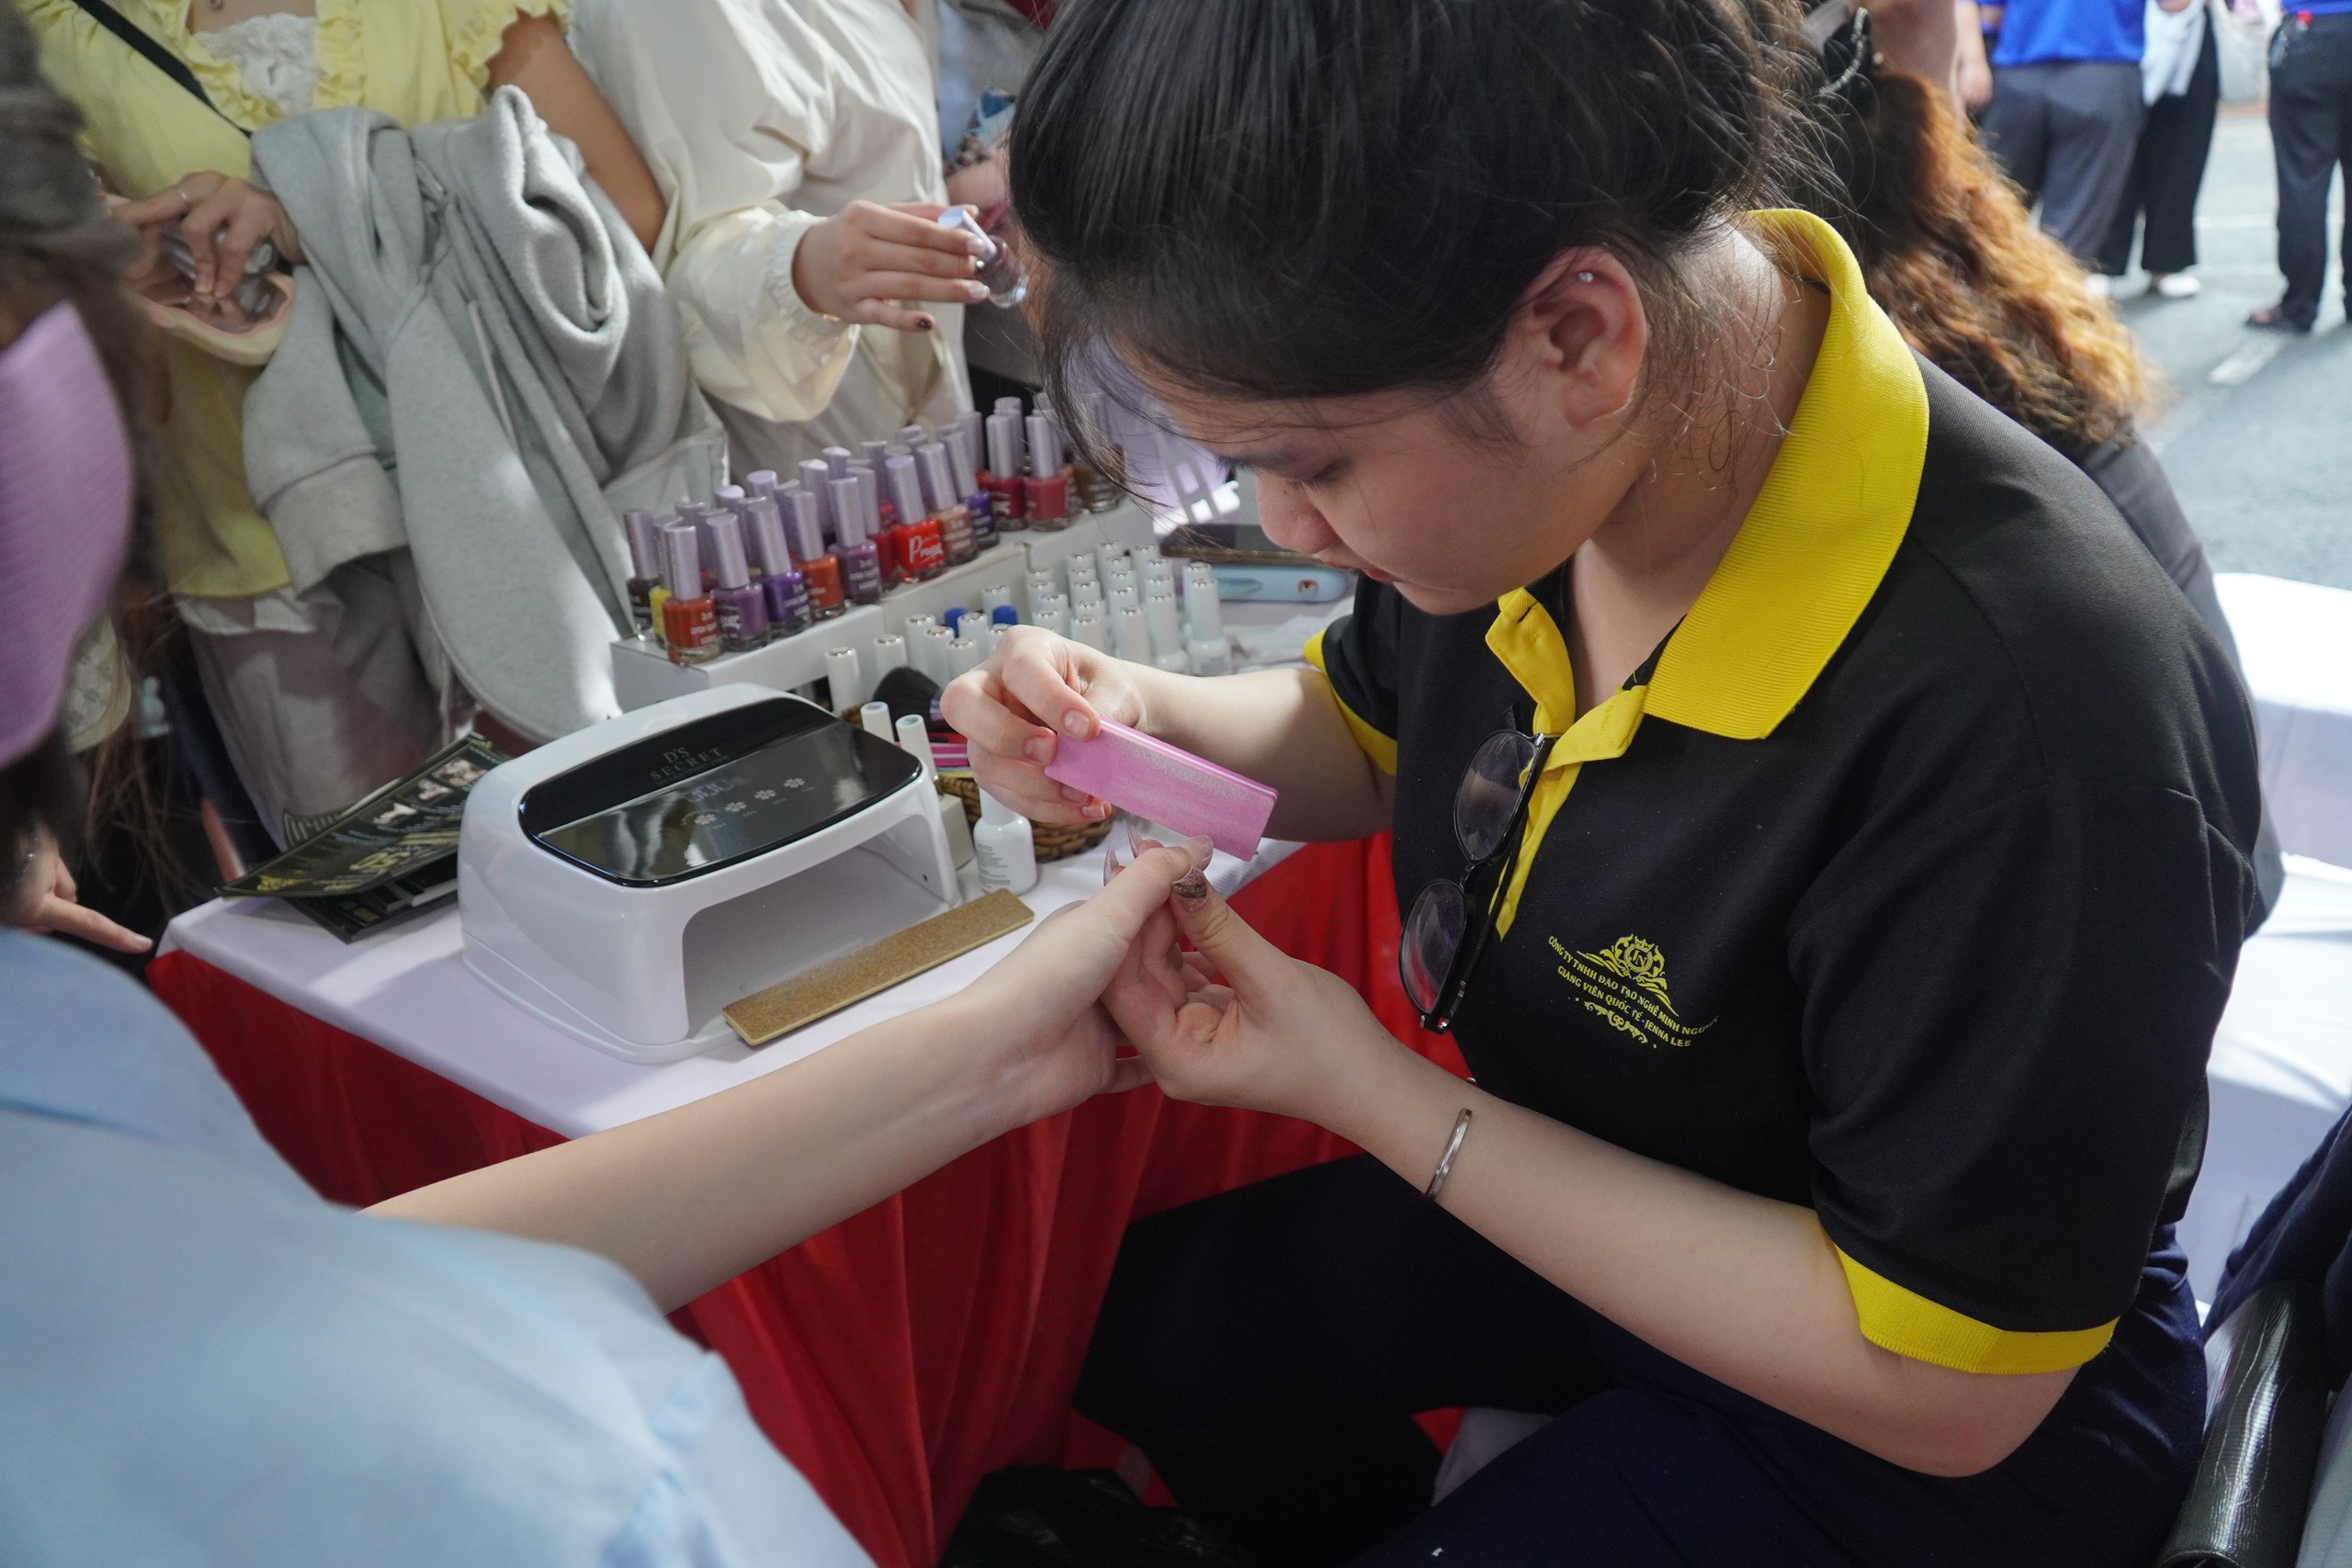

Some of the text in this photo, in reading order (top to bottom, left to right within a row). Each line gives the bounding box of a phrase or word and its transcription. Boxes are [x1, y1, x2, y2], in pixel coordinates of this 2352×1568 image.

[650, 747, 722, 781] SECRET
[663, 747, 690, 763] D'S
[1548, 936, 1565, 955] CÔNG
[1563, 950, 1574, 964] TY
[1572, 958, 1598, 980] TNHH
[1657, 1010, 1680, 1032] MINH
[1582, 982, 1605, 1000] VIÊN
[1670, 1038, 1691, 1047] LEE
